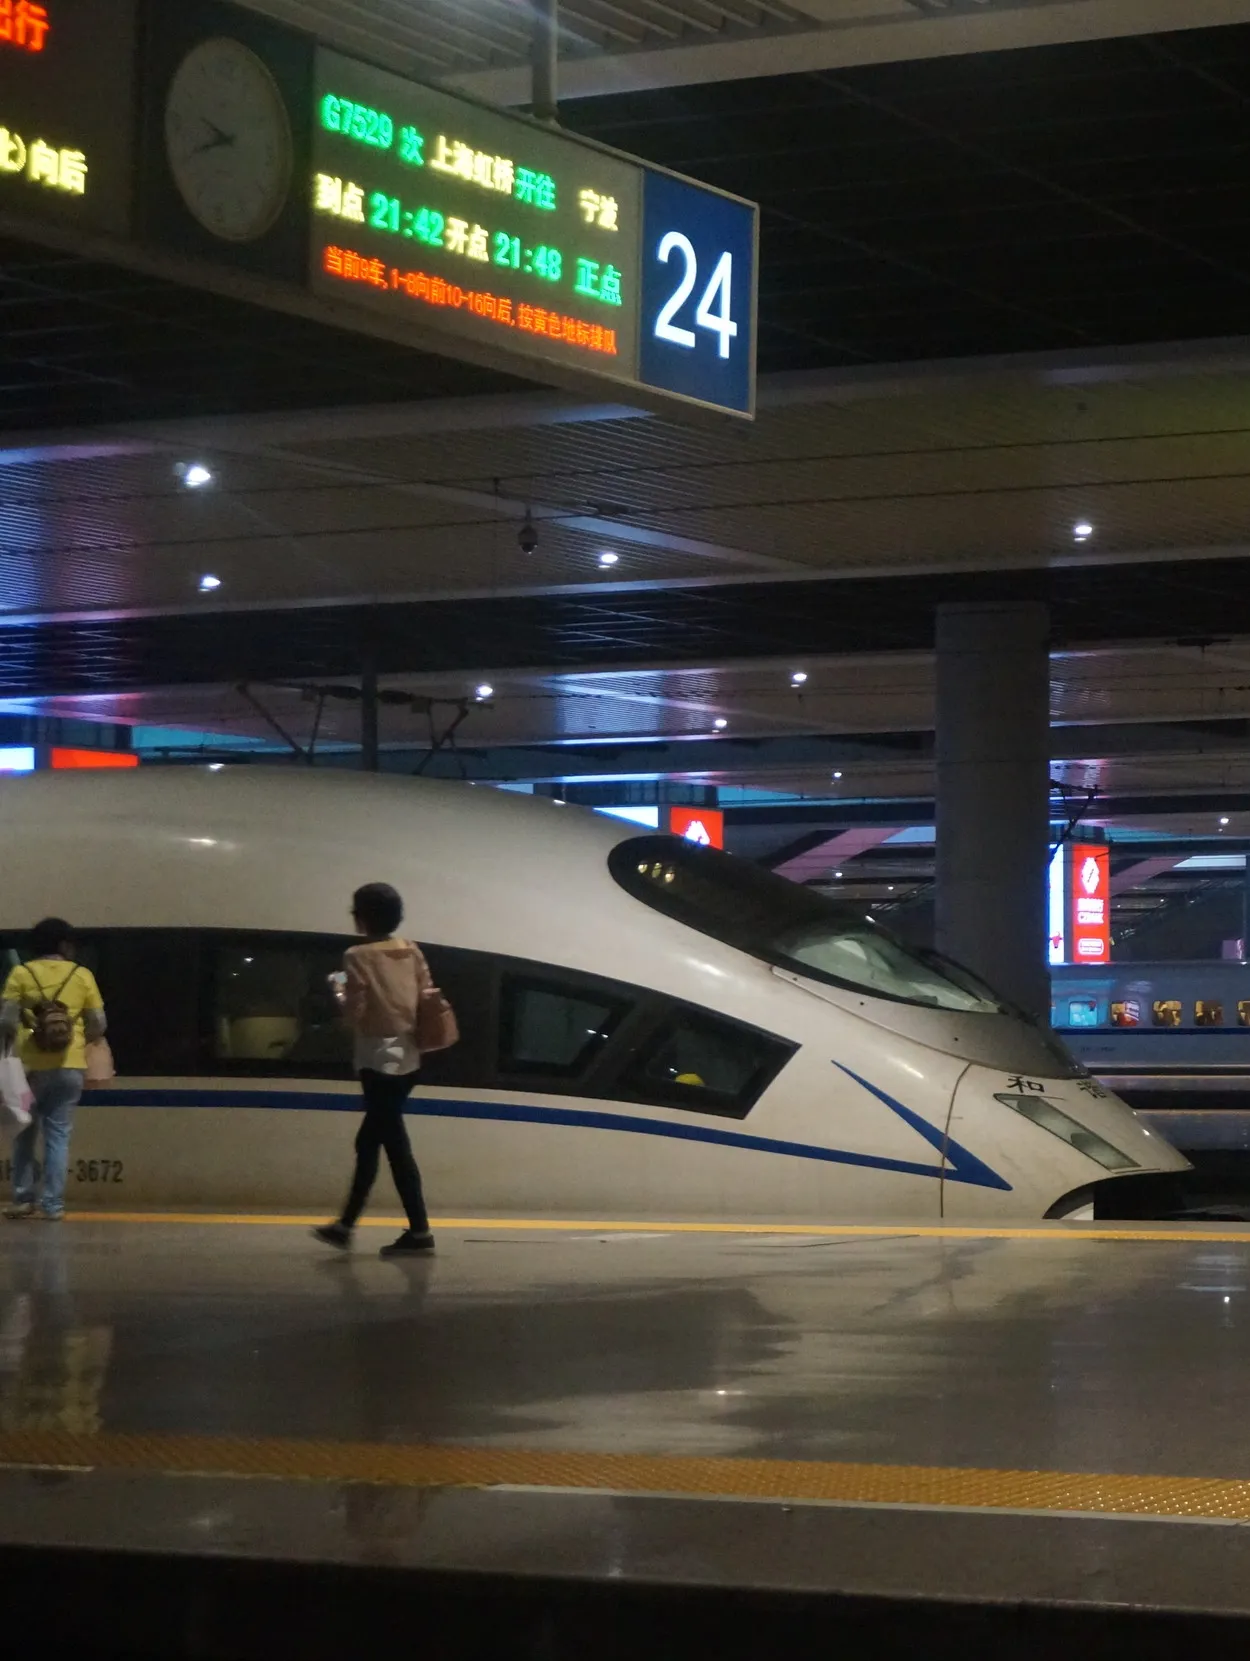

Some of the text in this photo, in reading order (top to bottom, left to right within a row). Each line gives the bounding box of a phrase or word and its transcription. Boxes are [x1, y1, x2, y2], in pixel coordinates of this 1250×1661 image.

[324, 94, 393, 148] G7529
[401, 126, 425, 166] 次
[579, 188, 619, 232] 宁波
[314, 172, 622, 307] 到点 21:42 开点 21:48 正点
[655, 230, 738, 359] 24
[1006, 1075, 1045, 1093] 和
